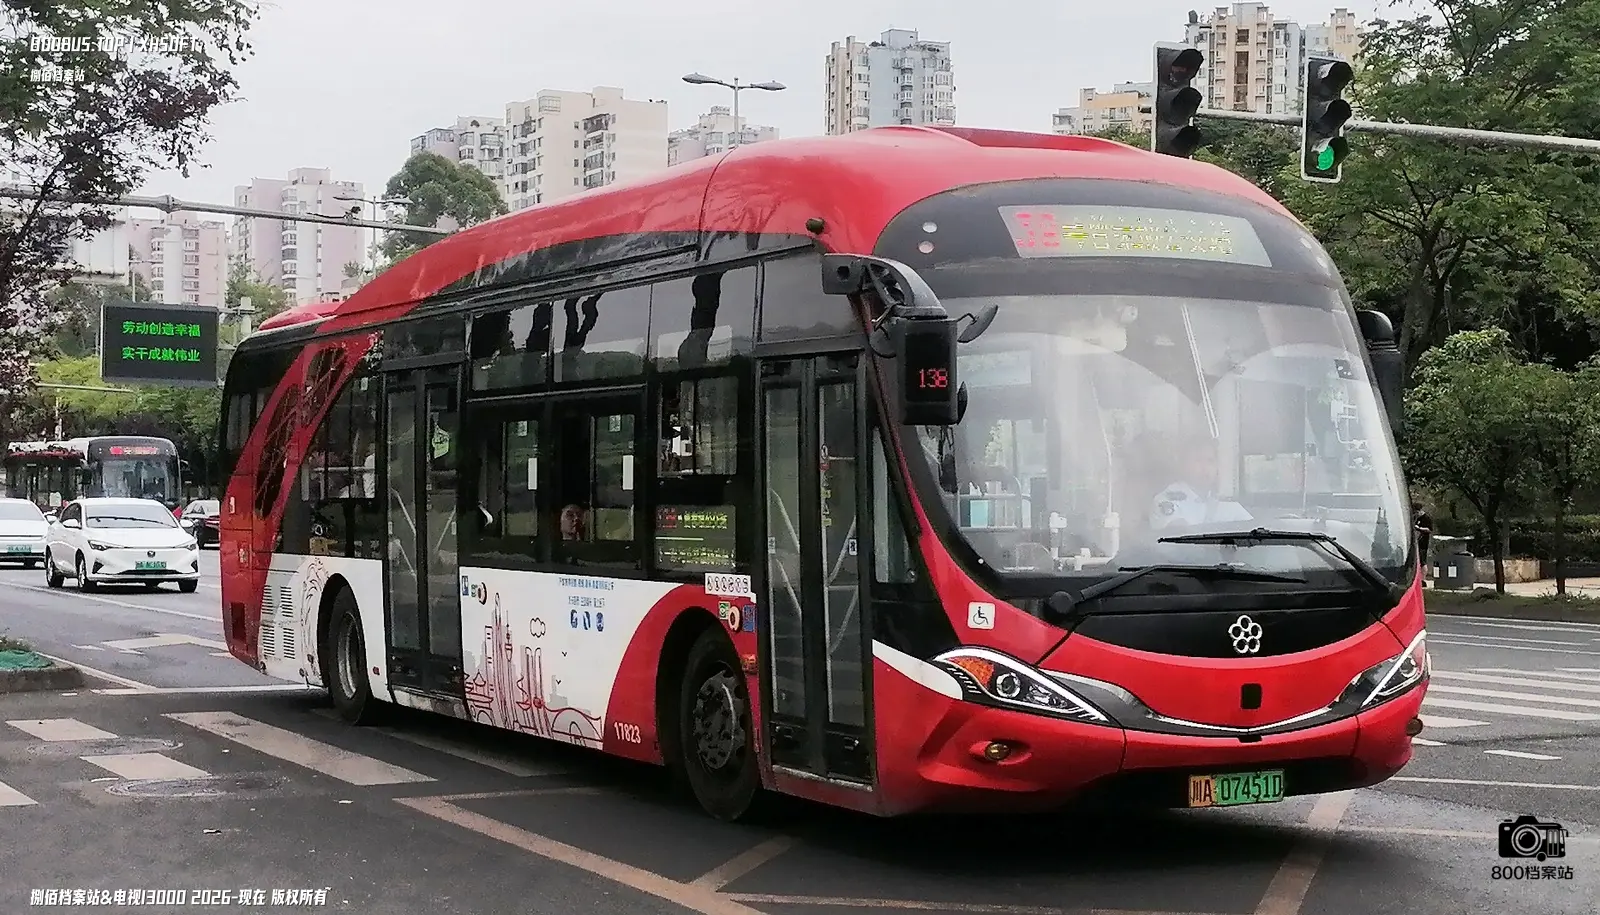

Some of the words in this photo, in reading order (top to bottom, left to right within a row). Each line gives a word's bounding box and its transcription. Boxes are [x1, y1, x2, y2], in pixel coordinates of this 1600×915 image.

[122, 321, 201, 337] 劳动创造幸福
[122, 346, 201, 362] 实干成就伟业
[919, 368, 949, 388] 138
[613, 721, 642, 745] 17823
